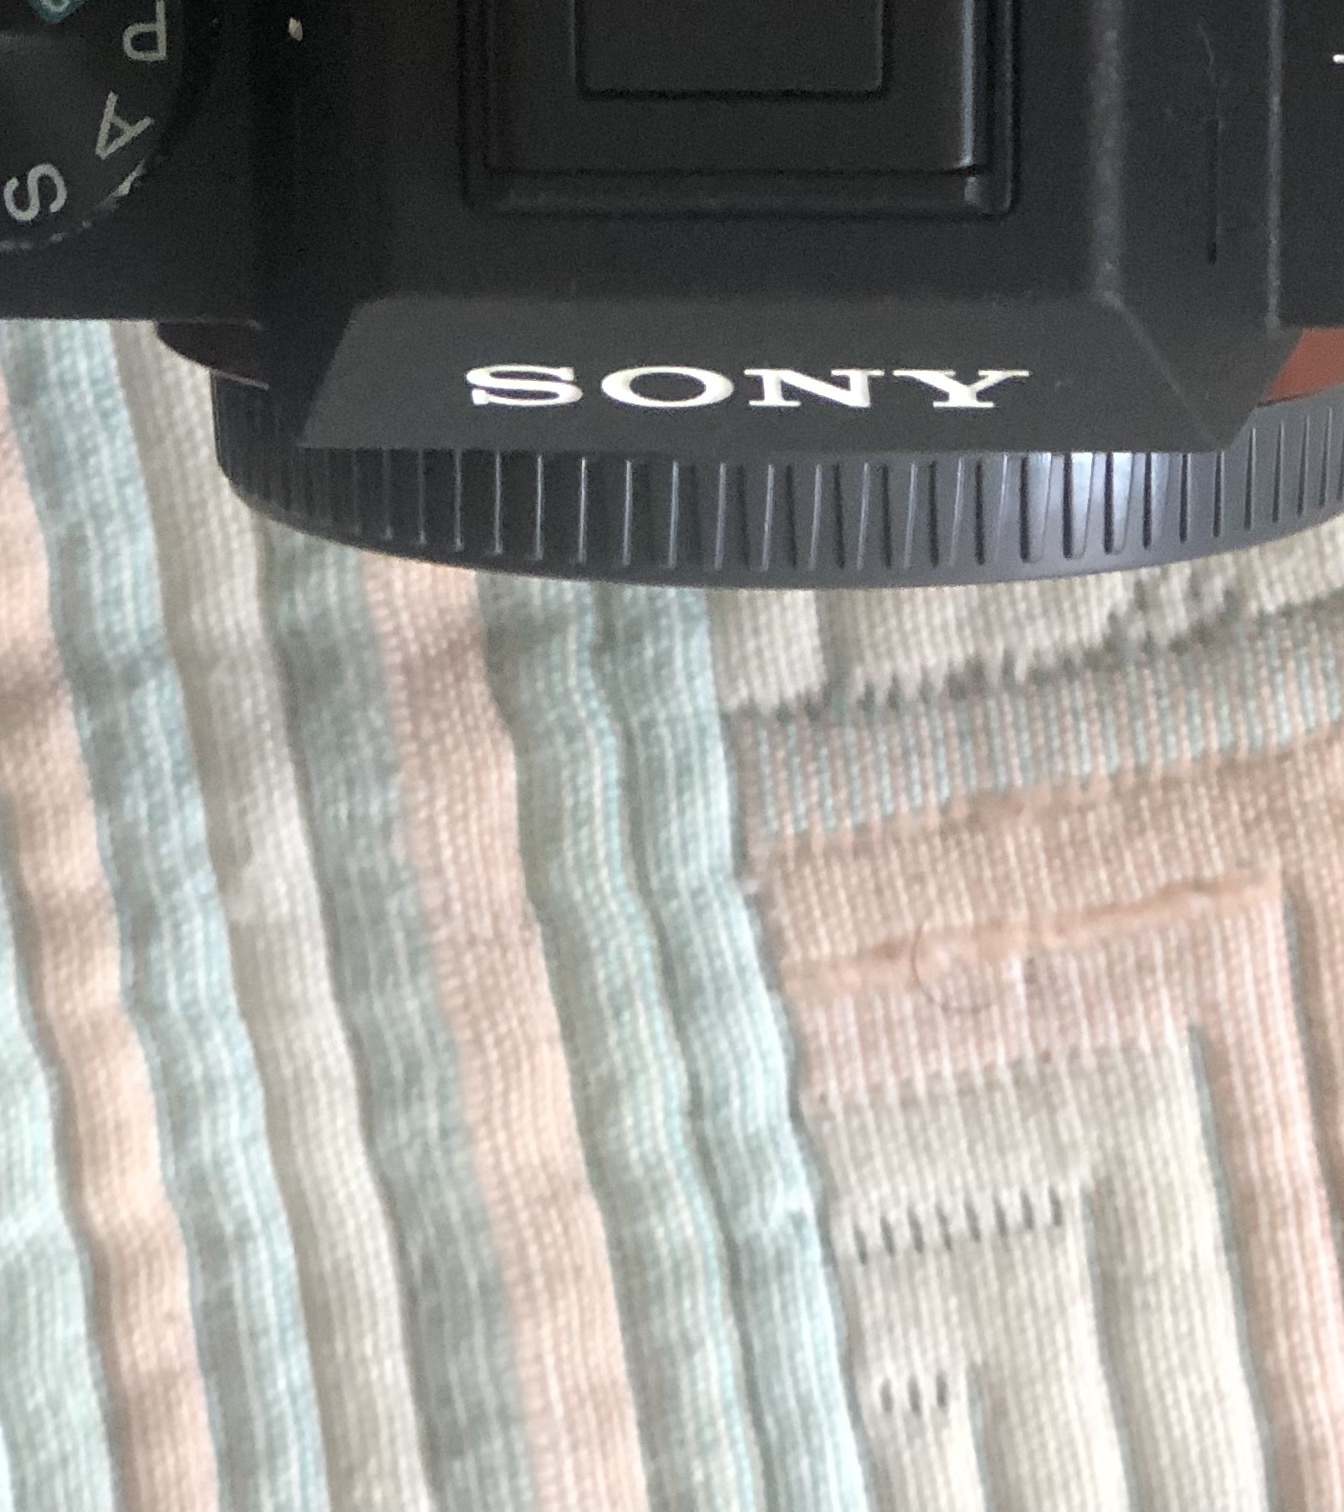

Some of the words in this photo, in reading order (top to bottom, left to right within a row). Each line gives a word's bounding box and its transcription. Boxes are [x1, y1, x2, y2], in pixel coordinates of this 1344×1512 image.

[94, 91, 154, 161] A
[3, 163, 68, 222] S
[465, 364, 1030, 409] SONY
